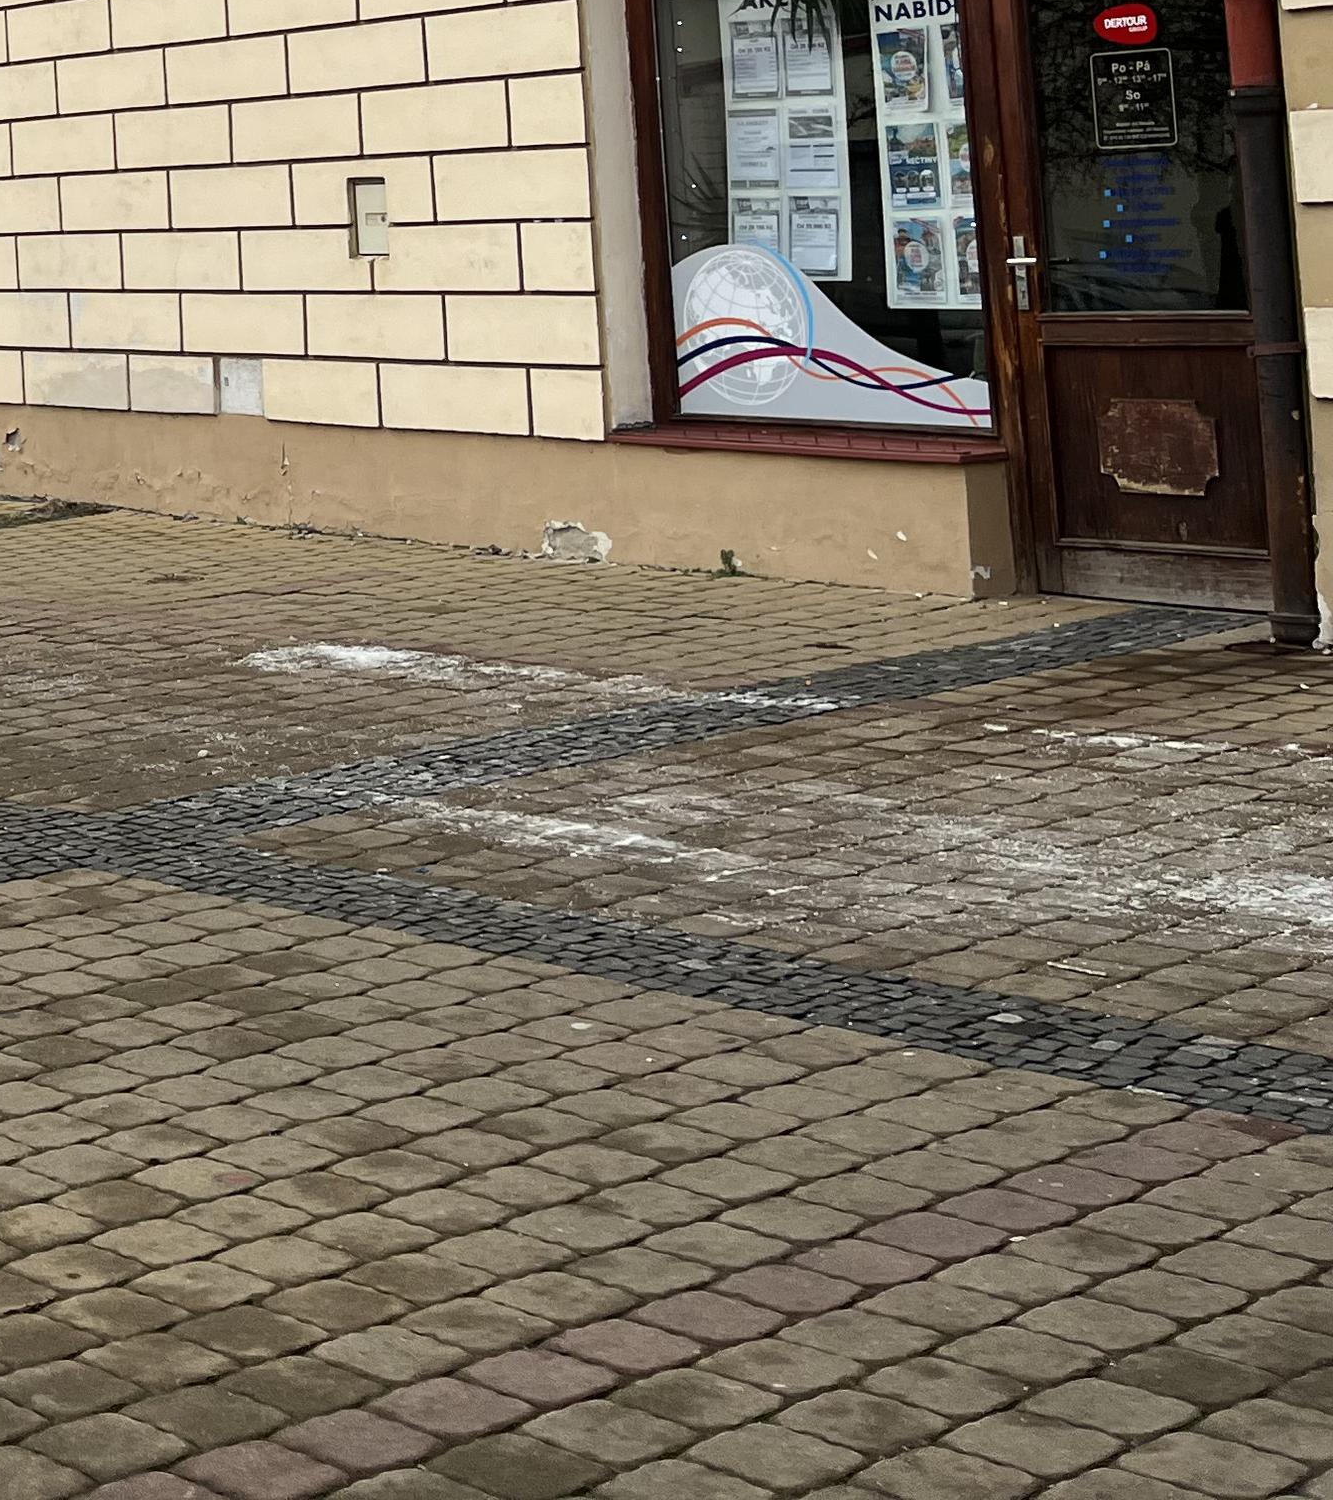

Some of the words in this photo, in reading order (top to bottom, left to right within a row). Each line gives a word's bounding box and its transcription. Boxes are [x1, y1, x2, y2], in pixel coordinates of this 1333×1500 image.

[1104, 15, 1148, 30] DERTOUR
[1111, 62, 1127, 74] Po
[1136, 60, 1151, 72] Pá
[1125, 90, 1141, 100] So
